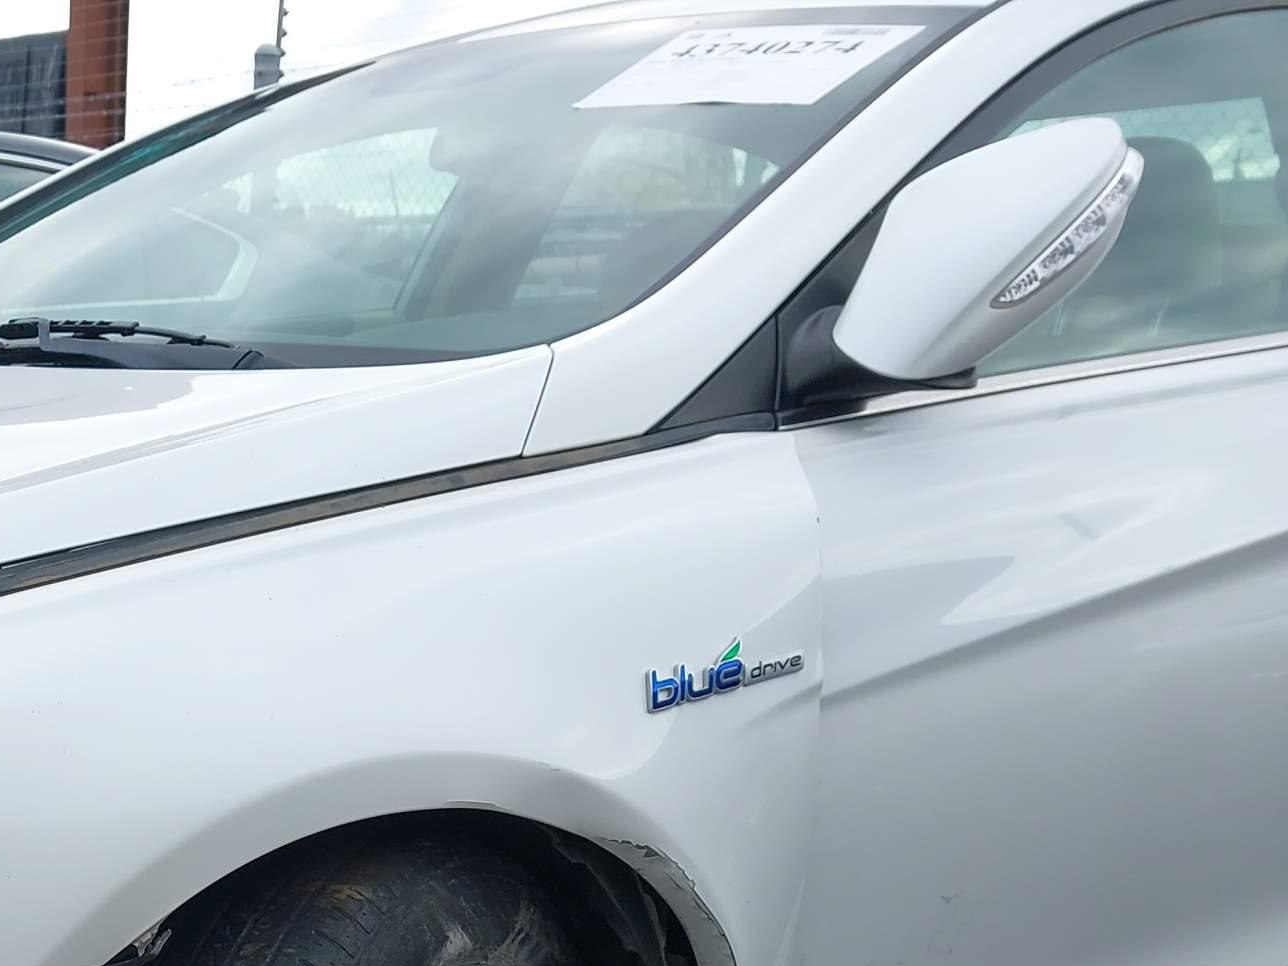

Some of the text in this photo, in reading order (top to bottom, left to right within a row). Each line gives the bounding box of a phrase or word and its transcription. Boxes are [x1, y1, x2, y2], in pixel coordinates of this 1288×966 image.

[672, 40, 865, 58] 43740274
[648, 654, 803, 712] blue drive
